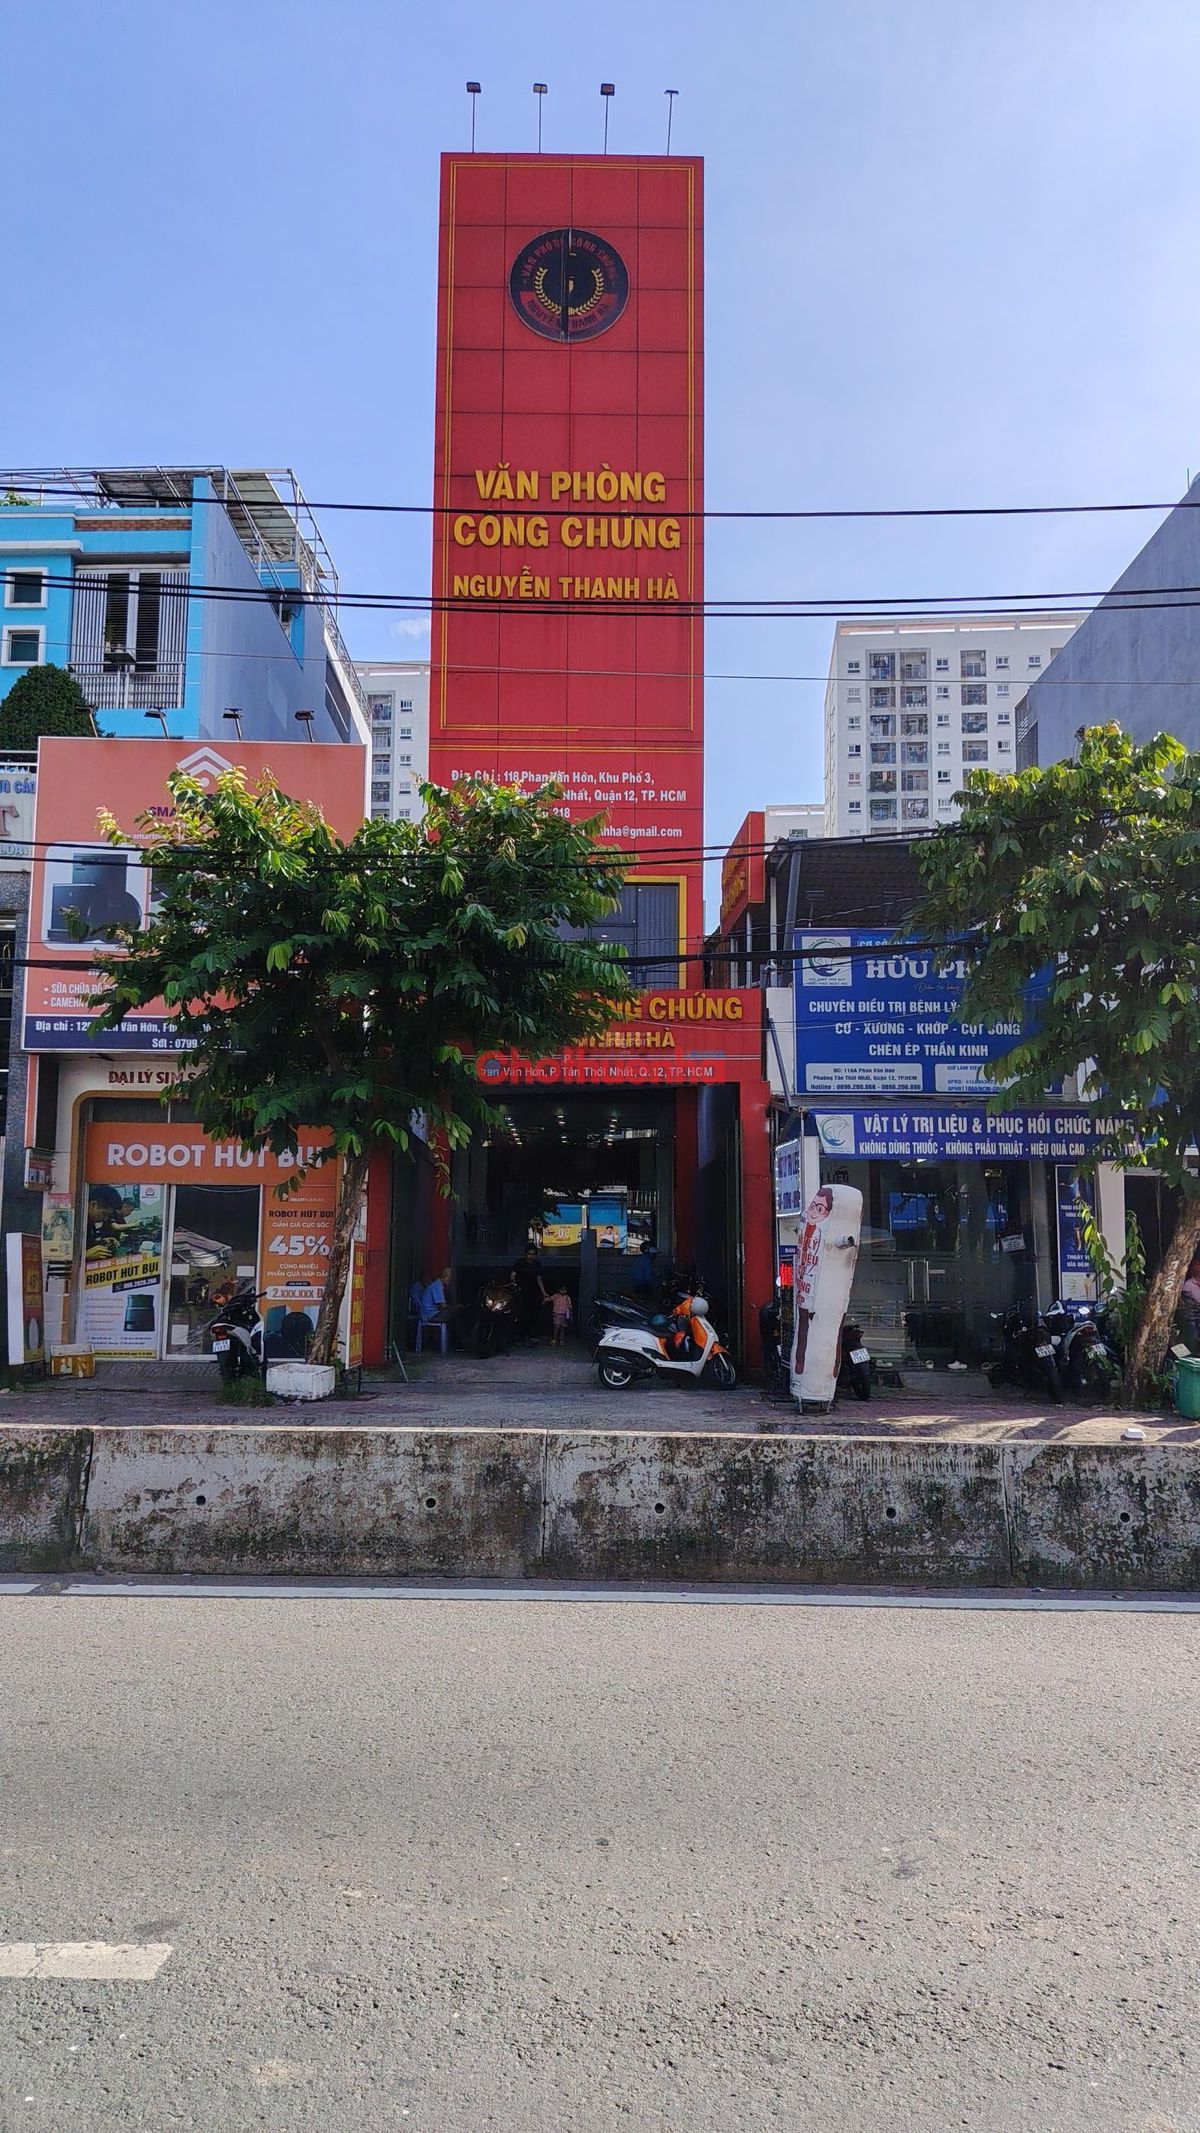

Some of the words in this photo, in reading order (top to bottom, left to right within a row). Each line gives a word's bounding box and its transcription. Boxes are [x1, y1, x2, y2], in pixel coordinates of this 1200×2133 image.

[475, 462, 539, 500] VĂN
[551, 463, 666, 502] PHÒNG
[560, 509, 680, 549] CHỨNG
[453, 565, 550, 598] NGUYỄN
[558, 576, 640, 600] THANH
[647, 572, 679, 600] HÀ
[503, 771, 518, 782] 118
[599, 772, 619, 783] Khu
[622, 770, 642, 783] Phố
[645, 773, 655, 785] 3,
[594, 792, 622, 804] Quận
[624, 791, 638, 804] 12,
[641, 790, 658, 802] TP.
[660, 791, 687, 802] HCM
[866, 954, 928, 978] HỮU
[649, 991, 743, 1020] CHỨNG
[809, 1000, 854, 1013] CHUYÊN
[858, 998, 885, 1013] ĐIỀU
[888, 1001, 907, 1016] TRỊ
[910, 999, 941, 1016] BỆNH
[944, 999, 958, 1013] LÝ
[35, 1021, 51, 1032] Địa
[121, 1021, 138, 1032] Văn
[869, 1042, 901, 1057] CHÈN
[904, 1043, 920, 1057] ÉP
[960, 1044, 989, 1057] KINH
[109, 1071, 134, 1085] ĐẠI
[138, 1069, 153, 1084] LÝ
[157, 1072, 184, 1084] SIM
[562, 1065, 580, 1077] Tân
[864, 1115, 889, 1136] VẬT
[892, 1113, 908, 1133] LÝ
[912, 1115, 934, 1137] TRỊ
[938, 1113, 967, 1136] LIỆU
[972, 1115, 982, 1133] &
[987, 1116, 1023, 1138] PHỤC
[1028, 1113, 1050, 1134] HỒI
[1055, 1114, 1092, 1134] CHỨC
[107, 1143, 207, 1168] ROBOT
[859, 1139, 886, 1154] KHÔNG
[889, 1139, 910, 1154] DÙNG
[912, 1137, 938, 1155] THUỐC
[998, 1141, 1023, 1157] THUẬT
[1030, 1141, 1050, 1158] HIỆU
[1069, 1142, 1085, 1155] CAO
[268, 1210, 299, 1218] ROBOT
[268, 1235, 331, 1256] 45%
[86, 1269, 118, 1285] ROBOT
[121, 1264, 140, 1279] HÚT
